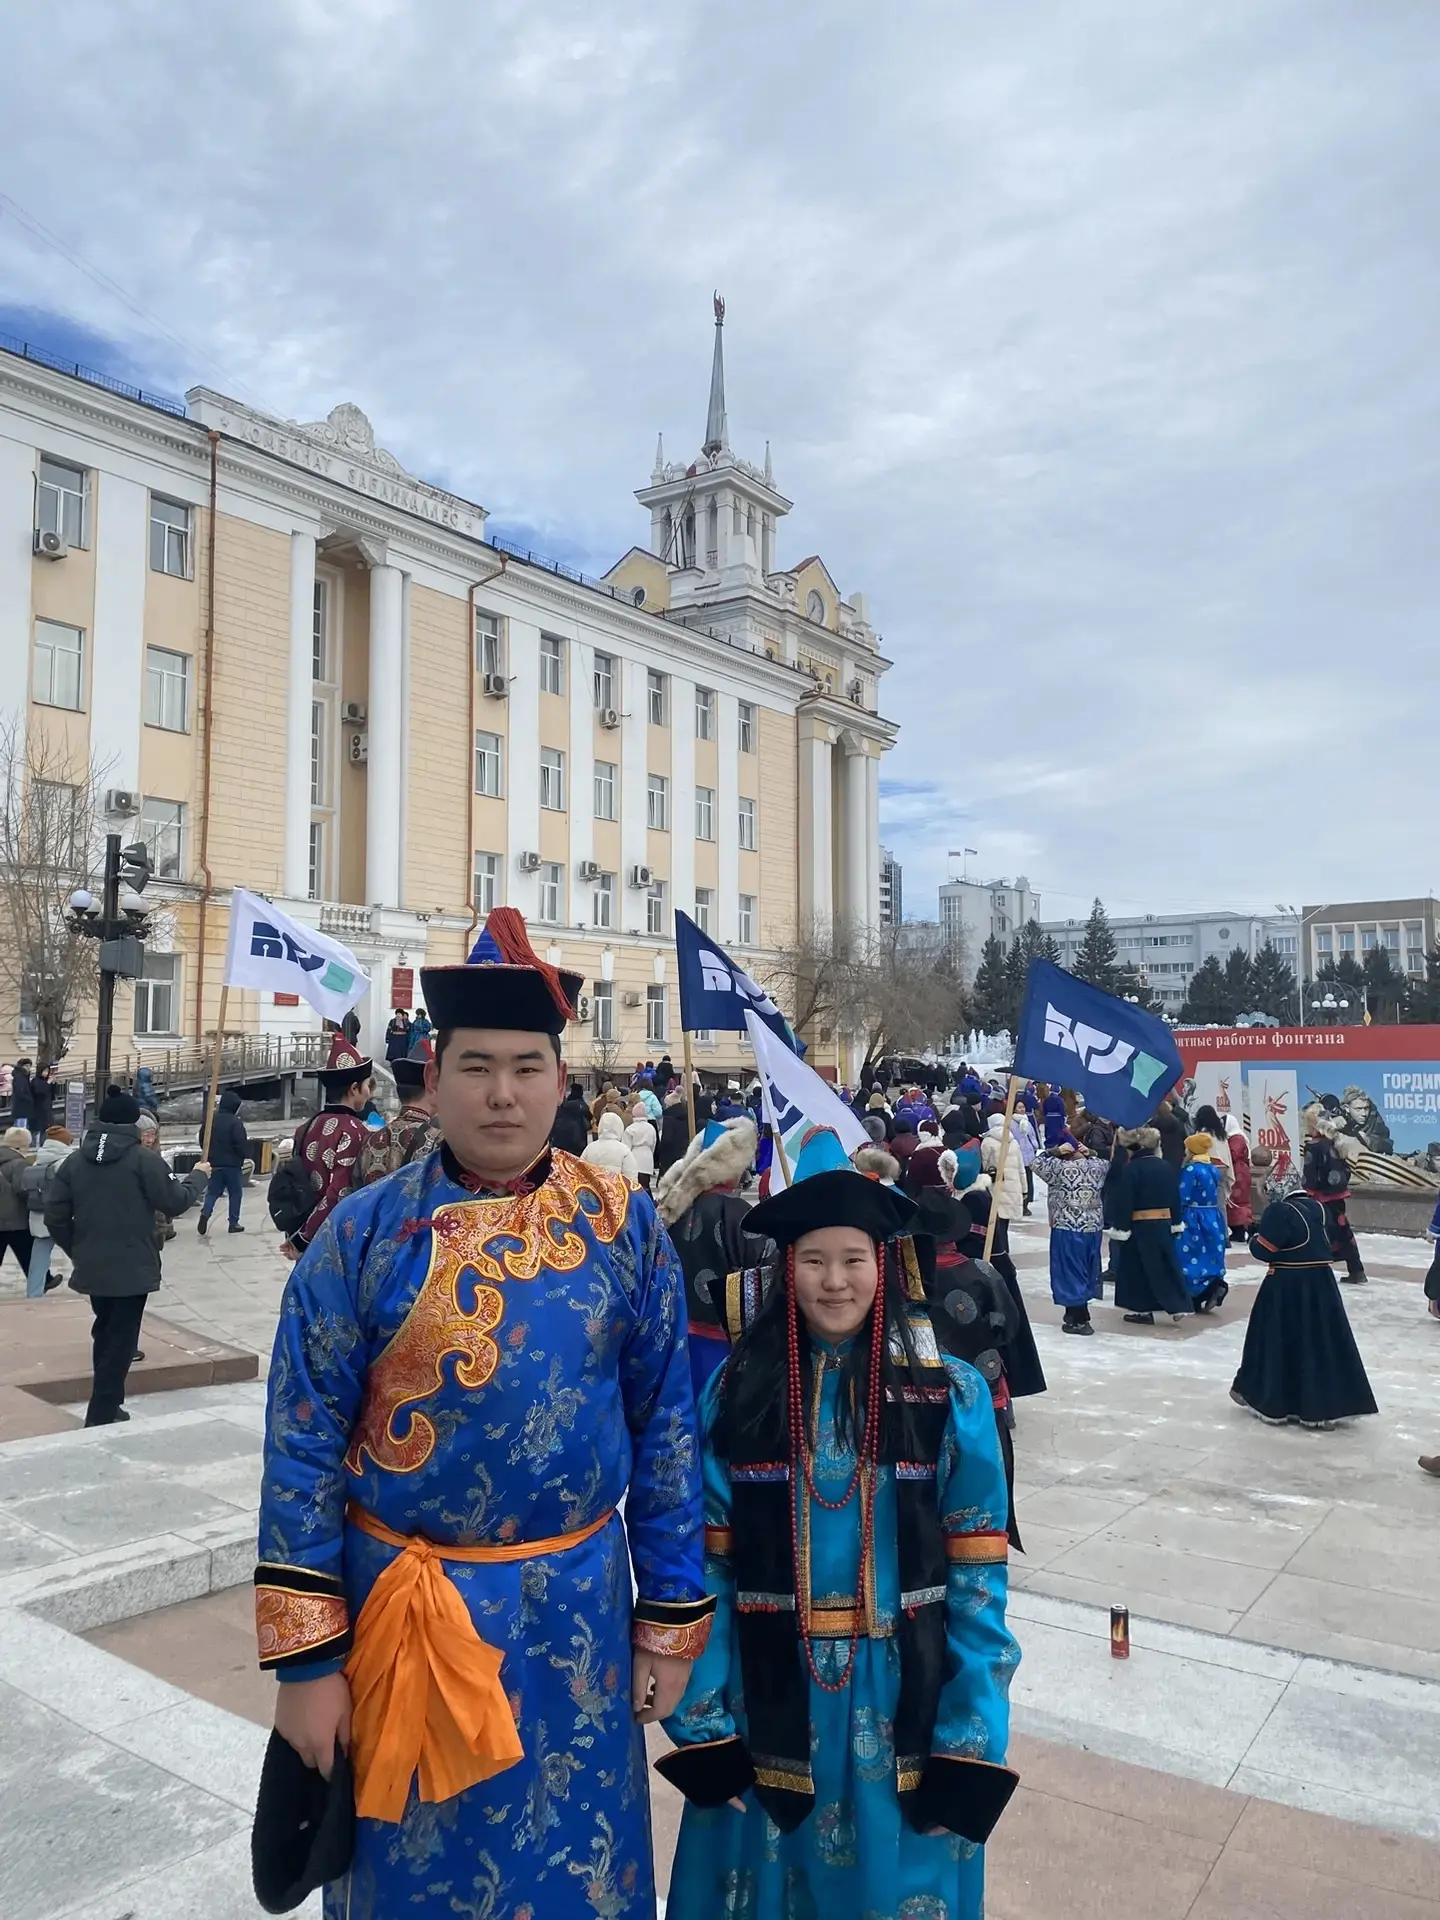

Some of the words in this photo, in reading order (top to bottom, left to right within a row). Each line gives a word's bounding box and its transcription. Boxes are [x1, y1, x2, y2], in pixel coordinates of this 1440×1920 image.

[240, 423, 332, 473] КОМБИНАТ
[1216, 1032, 1267, 1049] работы
[1271, 1031, 1345, 1048] фонтана
